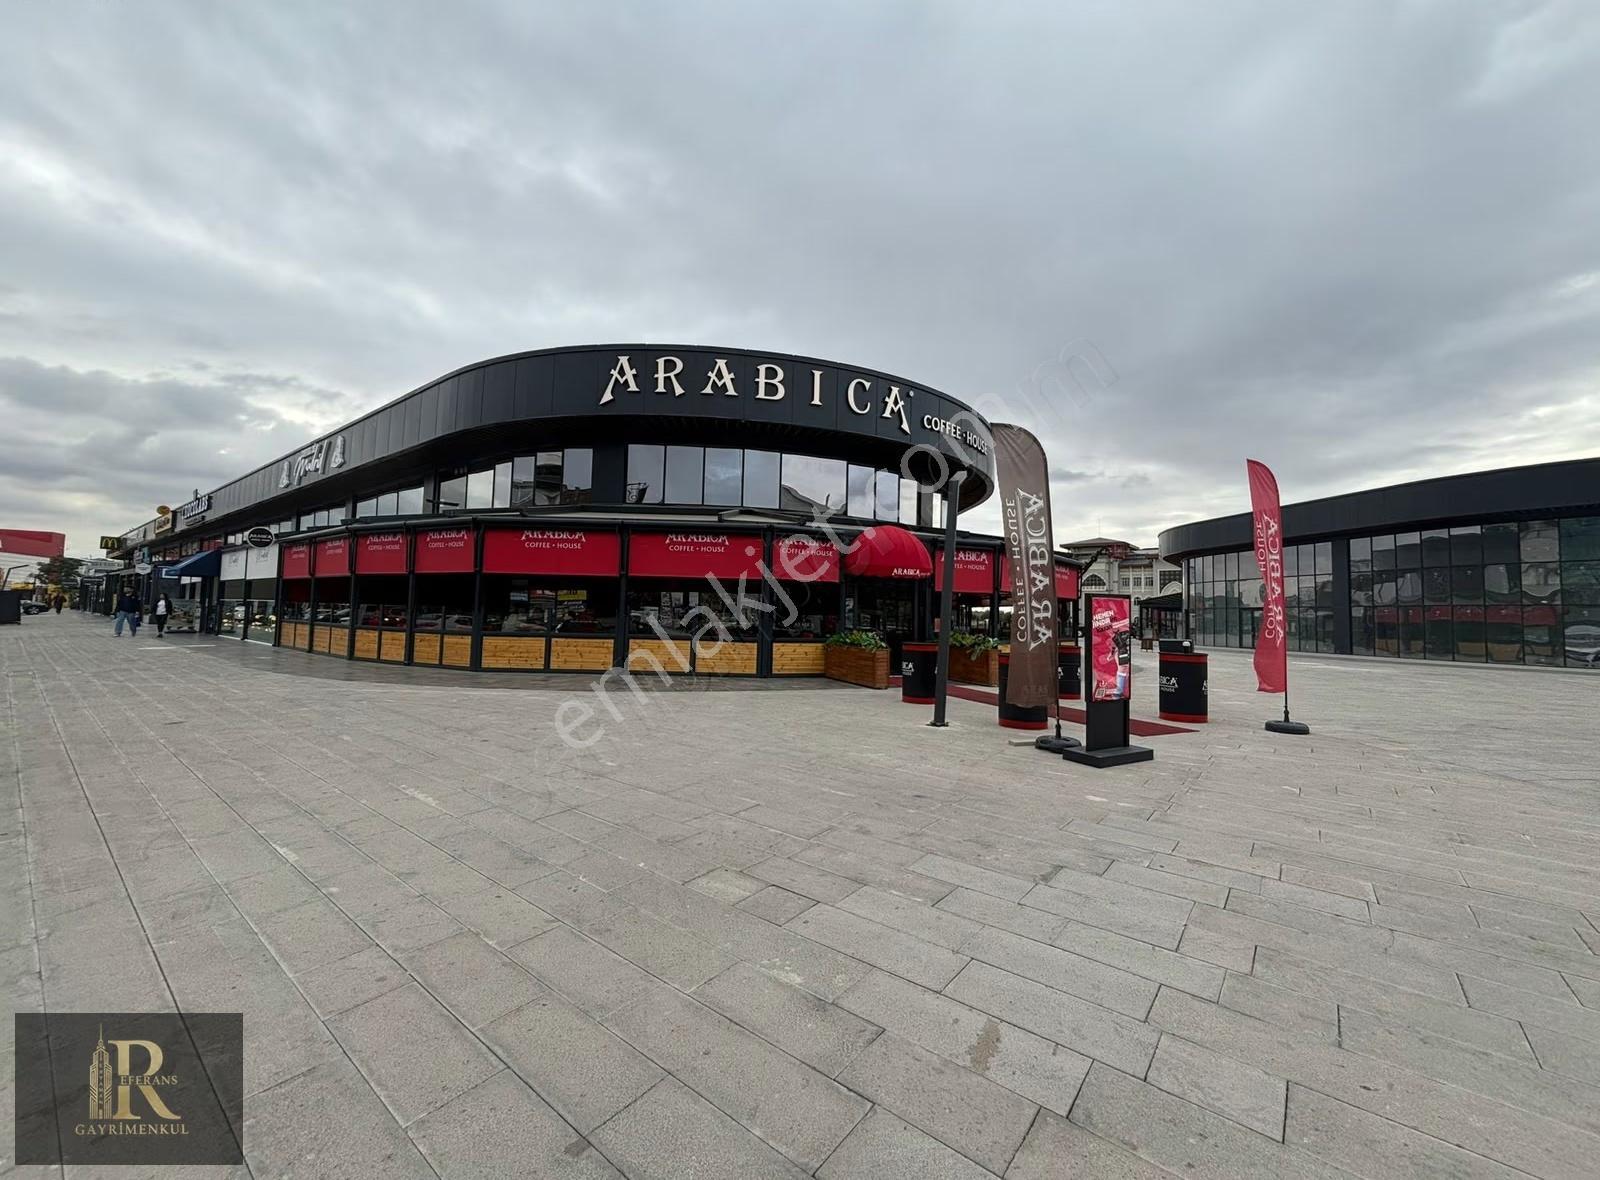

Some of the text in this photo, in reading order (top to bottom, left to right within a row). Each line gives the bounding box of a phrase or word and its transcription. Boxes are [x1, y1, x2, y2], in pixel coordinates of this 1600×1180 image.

[600, 355, 911, 434] ARABICA
[923, 414, 988, 456] COFFEE HOUSE
[525, 541, 550, 549] COFFEE
